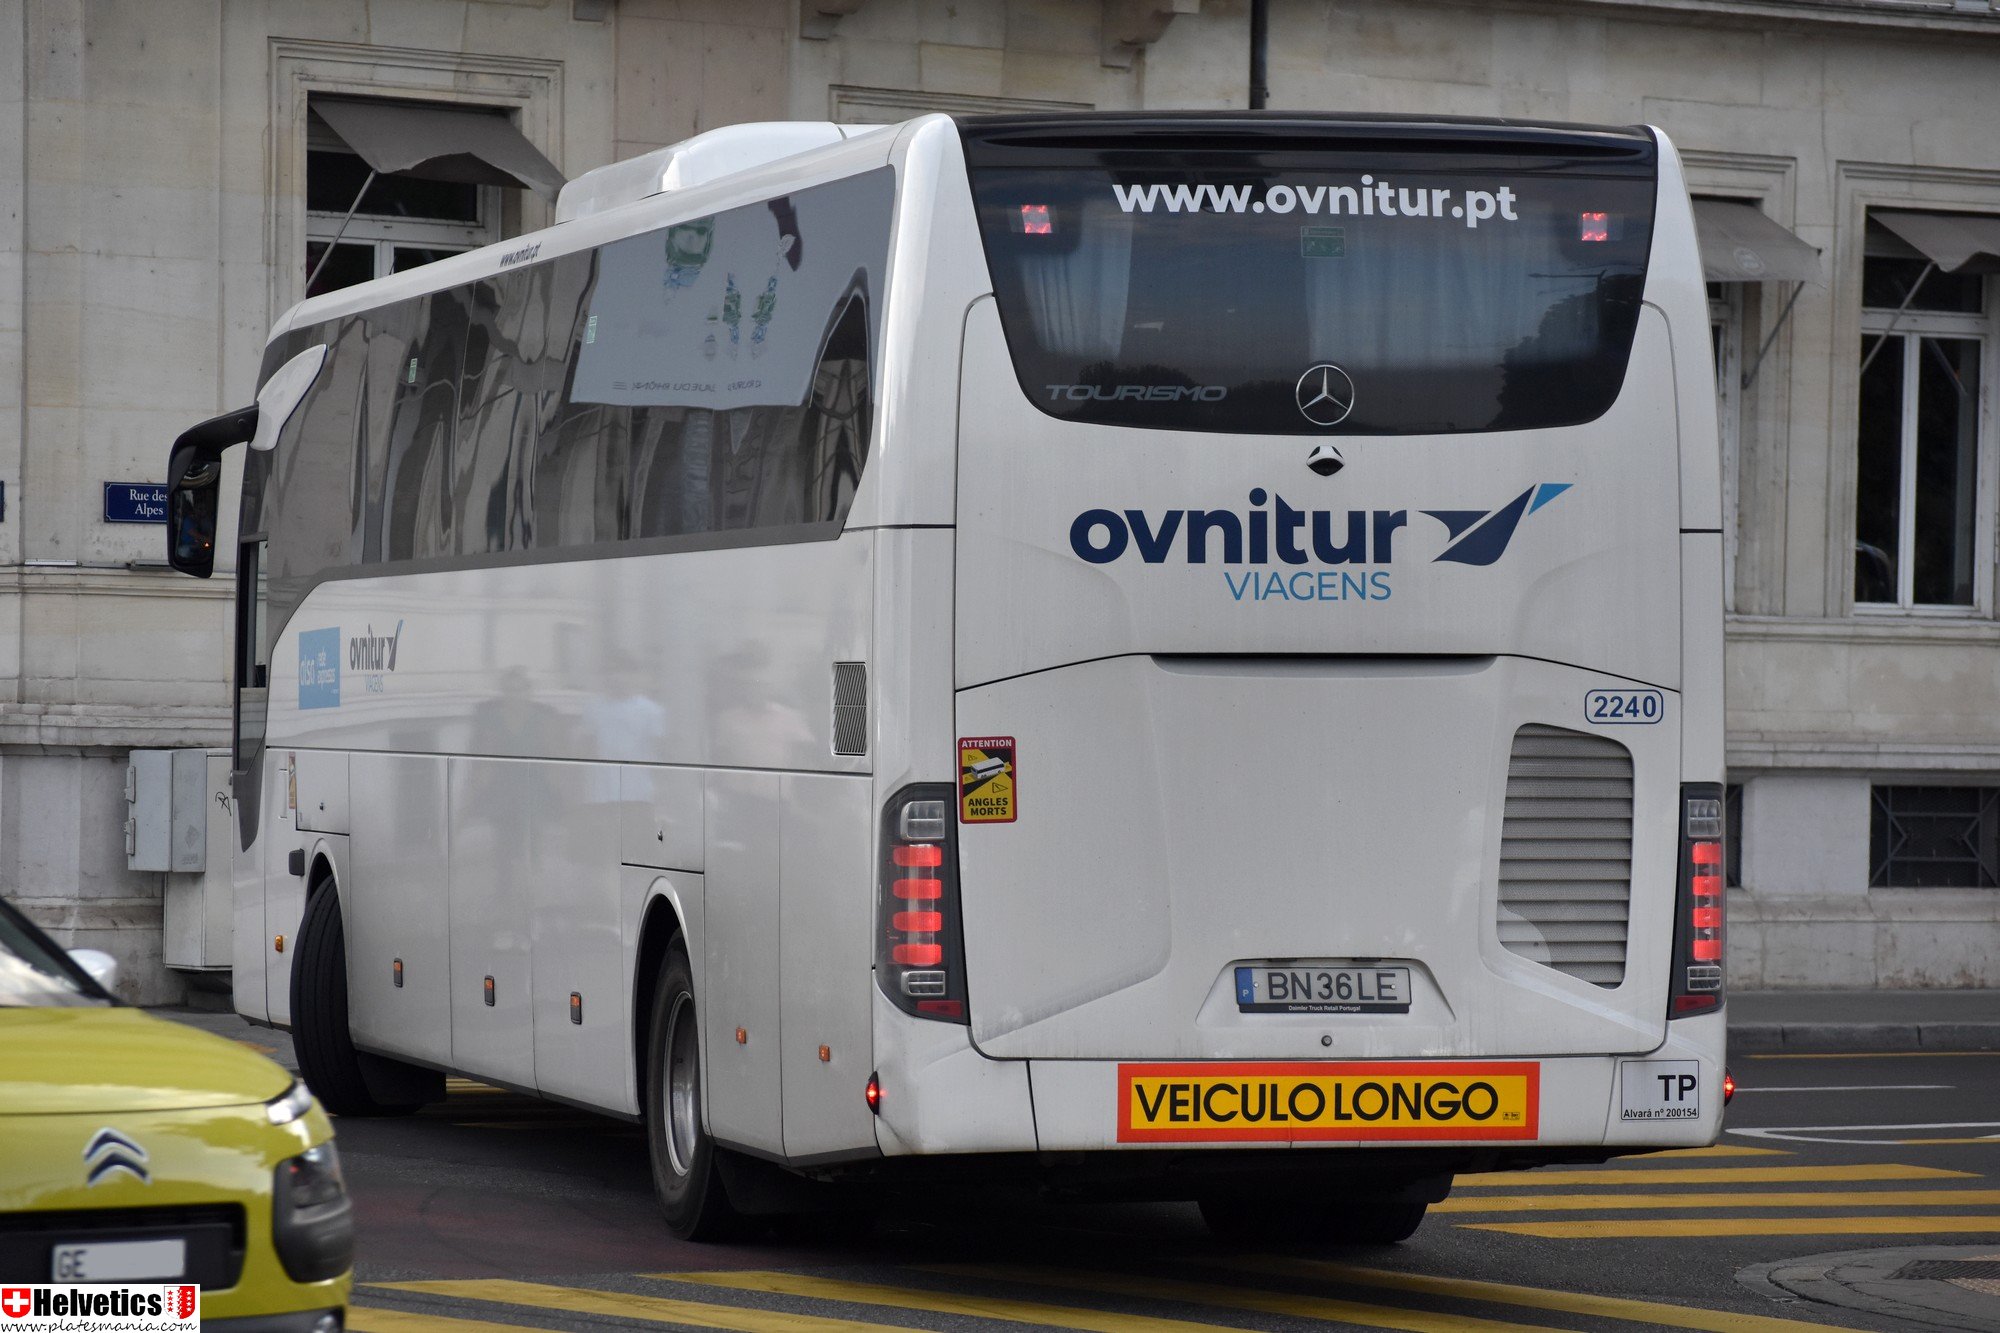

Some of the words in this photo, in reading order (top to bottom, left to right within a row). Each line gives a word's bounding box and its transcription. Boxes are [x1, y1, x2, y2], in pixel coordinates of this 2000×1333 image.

[1112, 174, 1518, 228] www.ovnitur.pt
[1046, 384, 1228, 402] TOURISMO
[130, 488, 149, 501] Rue
[135, 503, 164, 518] Alpes
[1069, 487, 1408, 565] ovnitur
[1223, 571, 1392, 601] VIAGENS
[349, 623, 386, 671] ovnitur
[1593, 695, 1657, 718] 2240
[961, 739, 1013, 748] ATTENTION
[968, 798, 1009, 807] ANGLES
[970, 807, 1007, 816] MORTS
[1242, 989, 1250, 998] P
[1657, 1074, 1697, 1102] TP
[1134, 1082, 1327, 1123] VEICULO
[1334, 1081, 1500, 1122] LONGO
[1623, 1109, 1652, 1118] Alvará
[1666, 1108, 1697, 1117] 200154
[58, 1249, 87, 1279] GE
